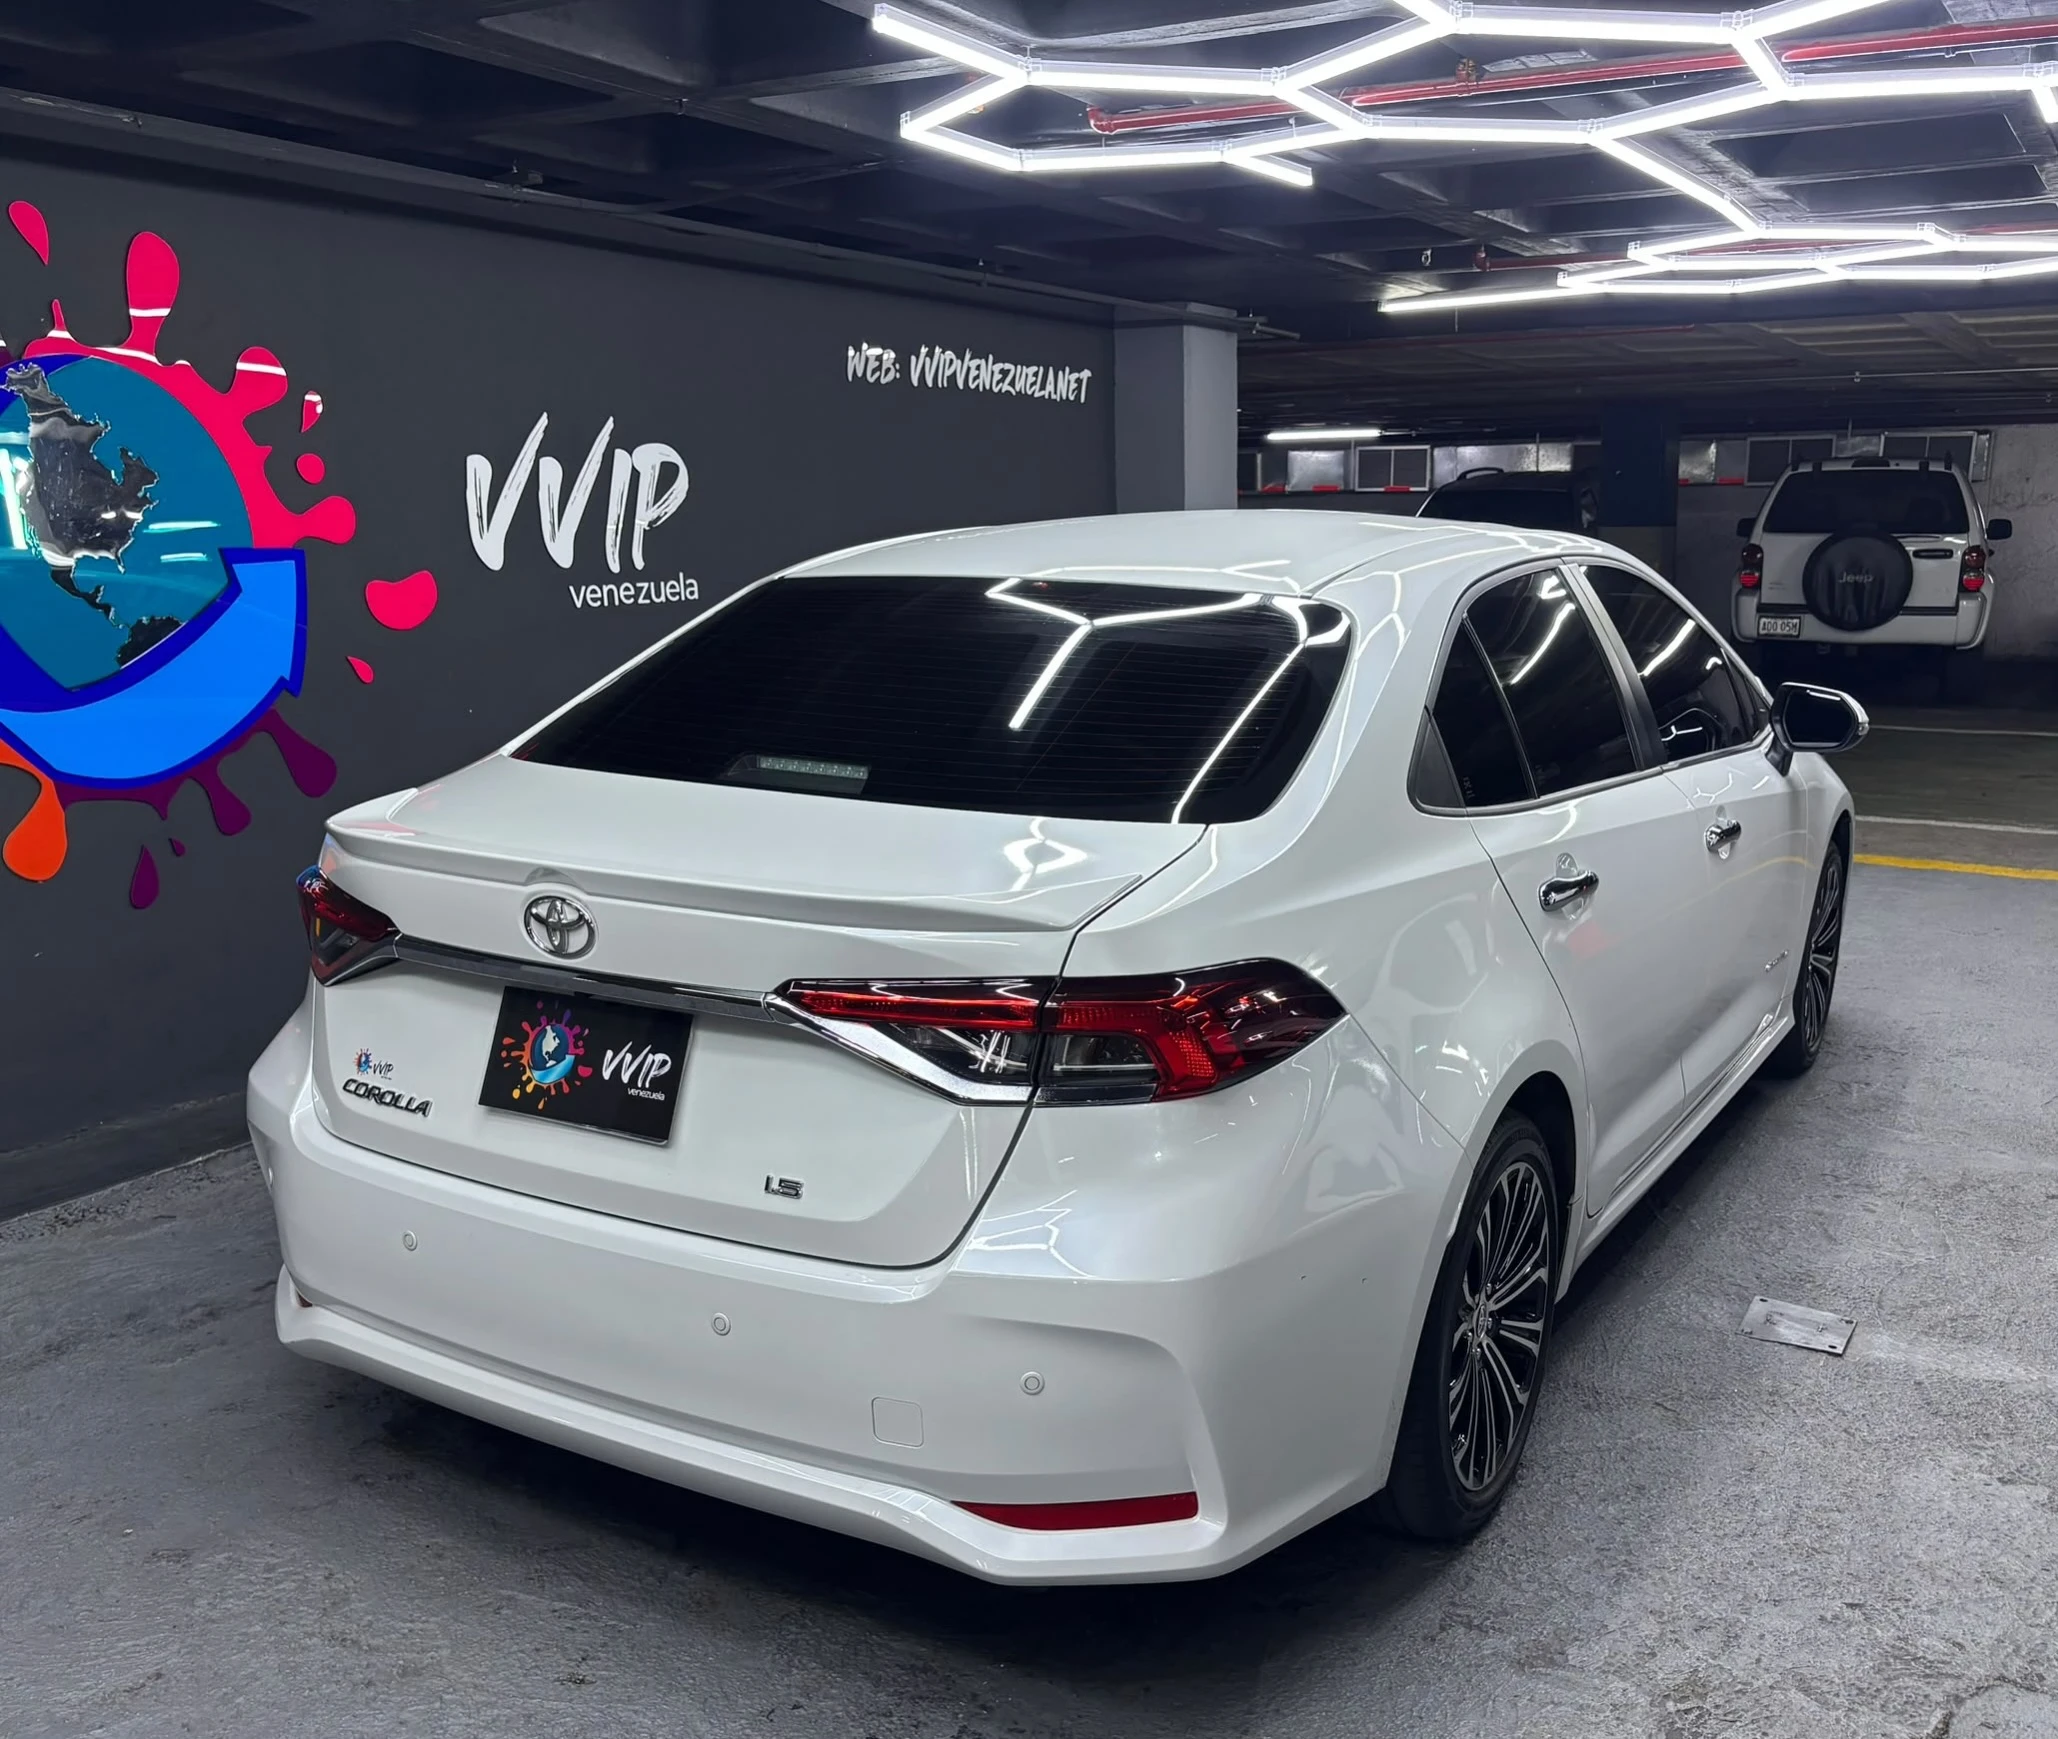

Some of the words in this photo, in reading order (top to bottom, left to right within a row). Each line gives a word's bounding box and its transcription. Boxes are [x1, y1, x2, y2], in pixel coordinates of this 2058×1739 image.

[848, 342, 900, 384] WEB:
[466, 411, 689, 574] VVIP
[569, 572, 699, 608] venezuela
[1838, 571, 1875, 584] Jeep
[602, 1041, 672, 1088] VVIP
[342, 1078, 433, 1117] COROLLA
[628, 1087, 666, 1101] venezuela
